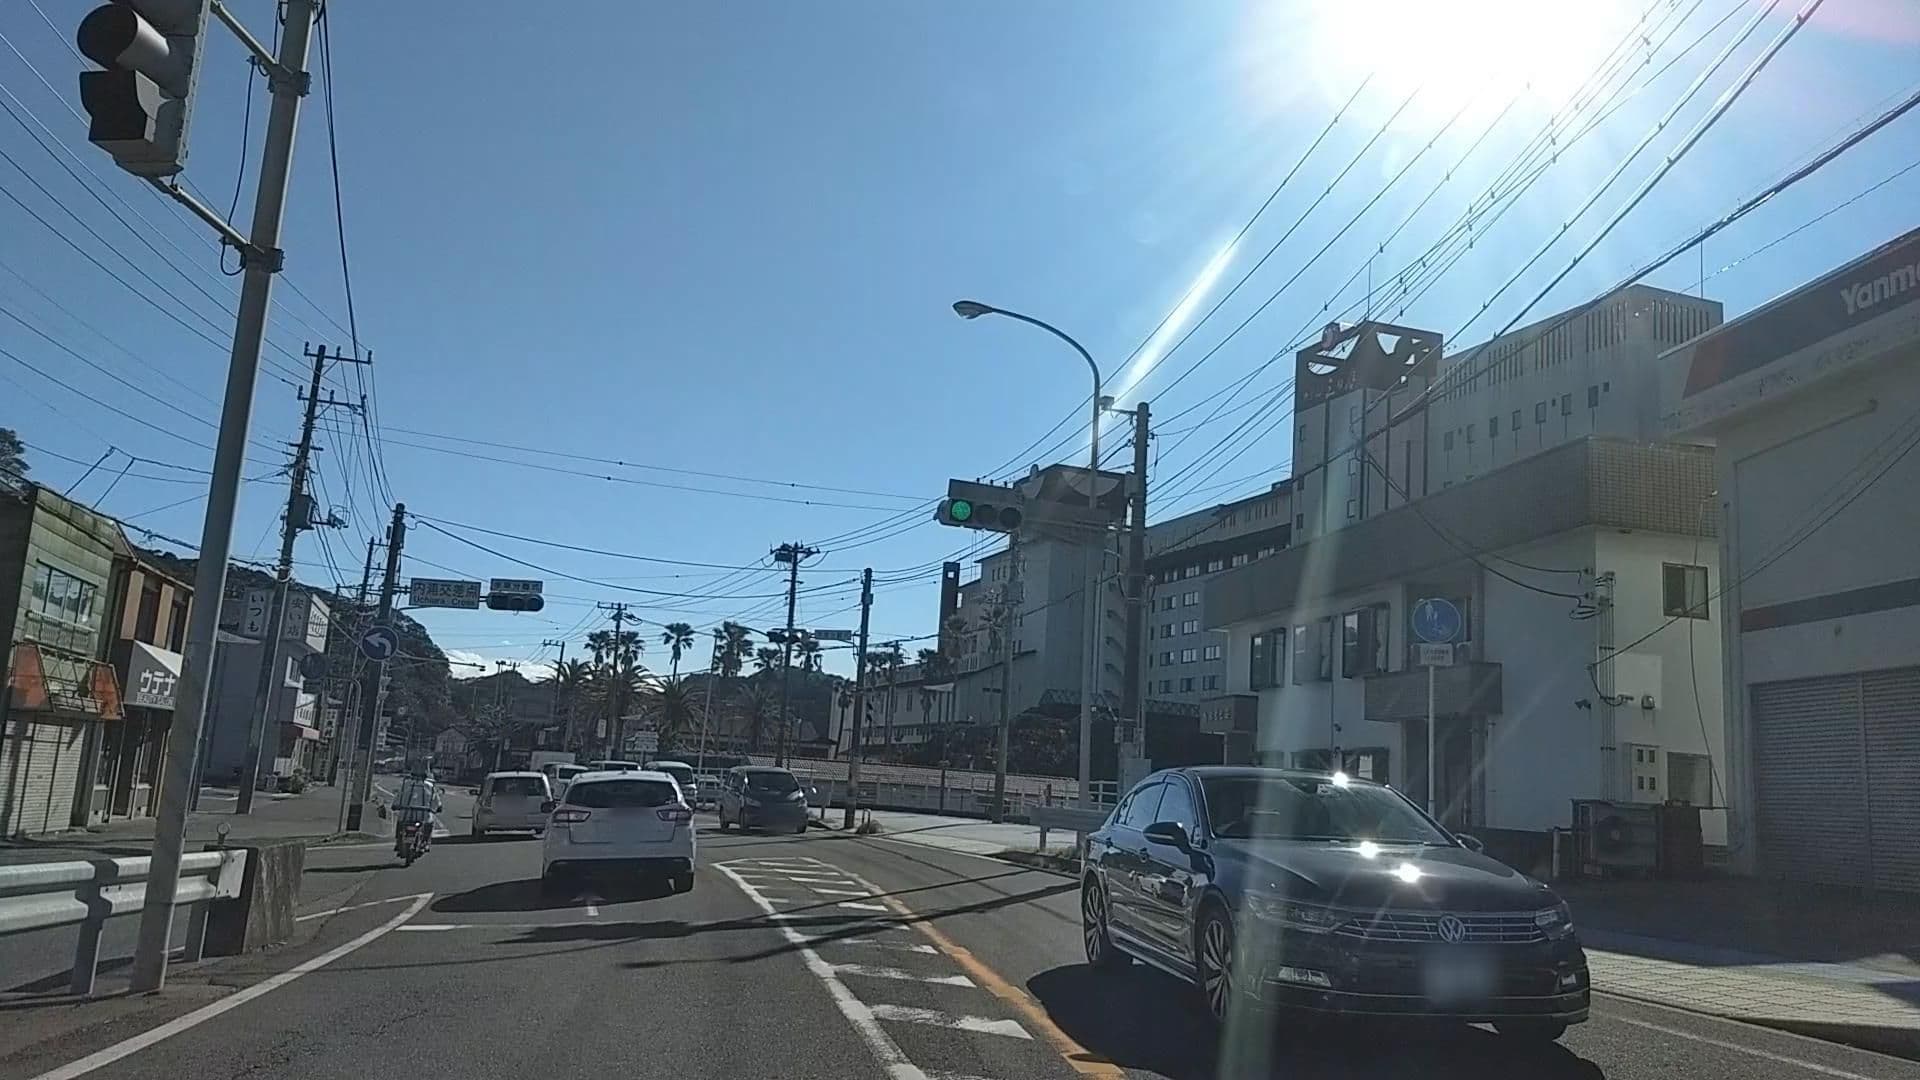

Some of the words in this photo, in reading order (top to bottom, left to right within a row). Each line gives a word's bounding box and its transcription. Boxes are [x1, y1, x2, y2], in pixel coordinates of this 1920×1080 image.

[1840, 264, 1920, 315] Yanm
[248, 594, 264, 633] いつも
[140, 669, 176, 696] ウテナ
